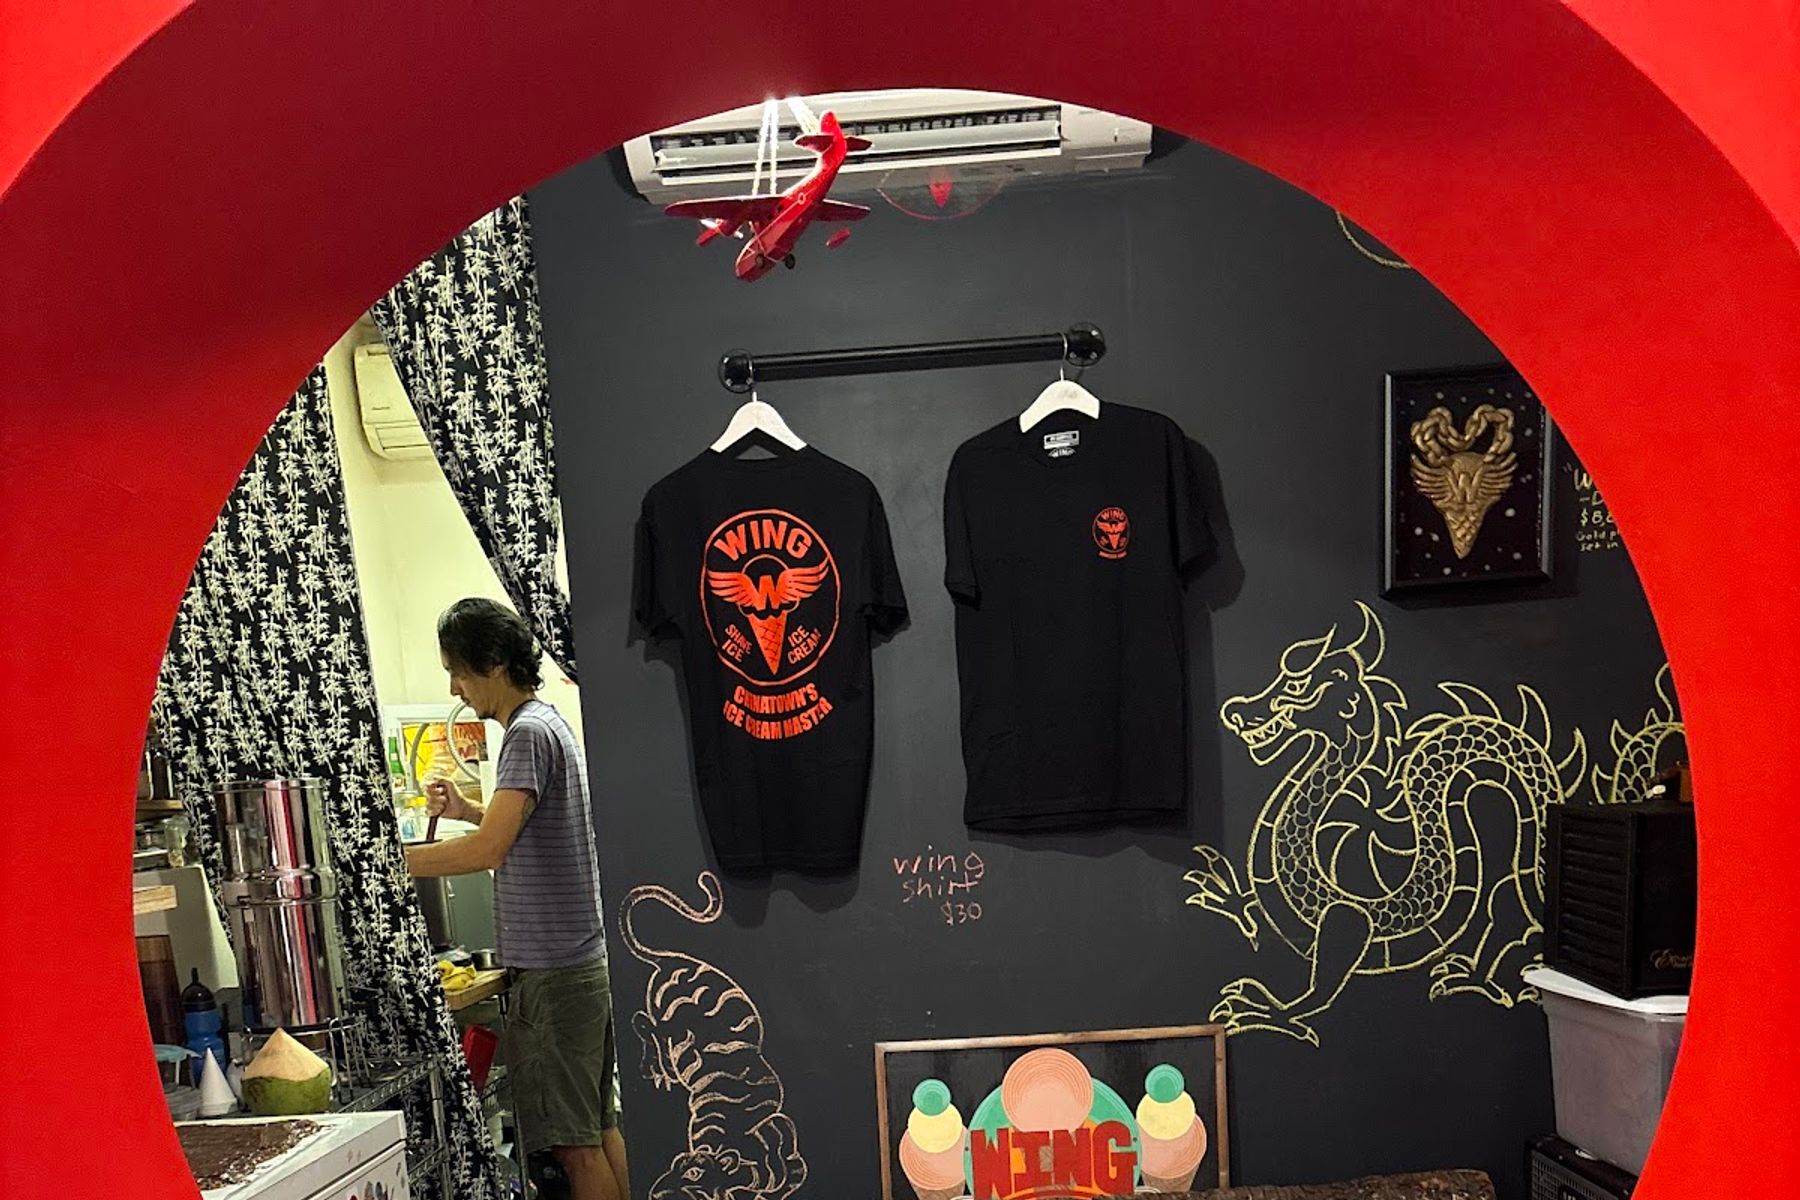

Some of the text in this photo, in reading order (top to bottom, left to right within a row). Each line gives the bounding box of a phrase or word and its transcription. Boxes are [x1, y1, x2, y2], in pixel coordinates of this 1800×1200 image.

[713, 519, 813, 561] WING
[722, 639, 743, 662] ICE
[787, 628, 821, 664] CREAM
[788, 625, 810, 648] ICE
[733, 682, 819, 714] CHINATOWN'S
[723, 696, 834, 740] ICE CREAM MASTER
[893, 844, 985, 879] wing
[902, 871, 979, 903] shirt
[940, 901, 983, 926] $30
